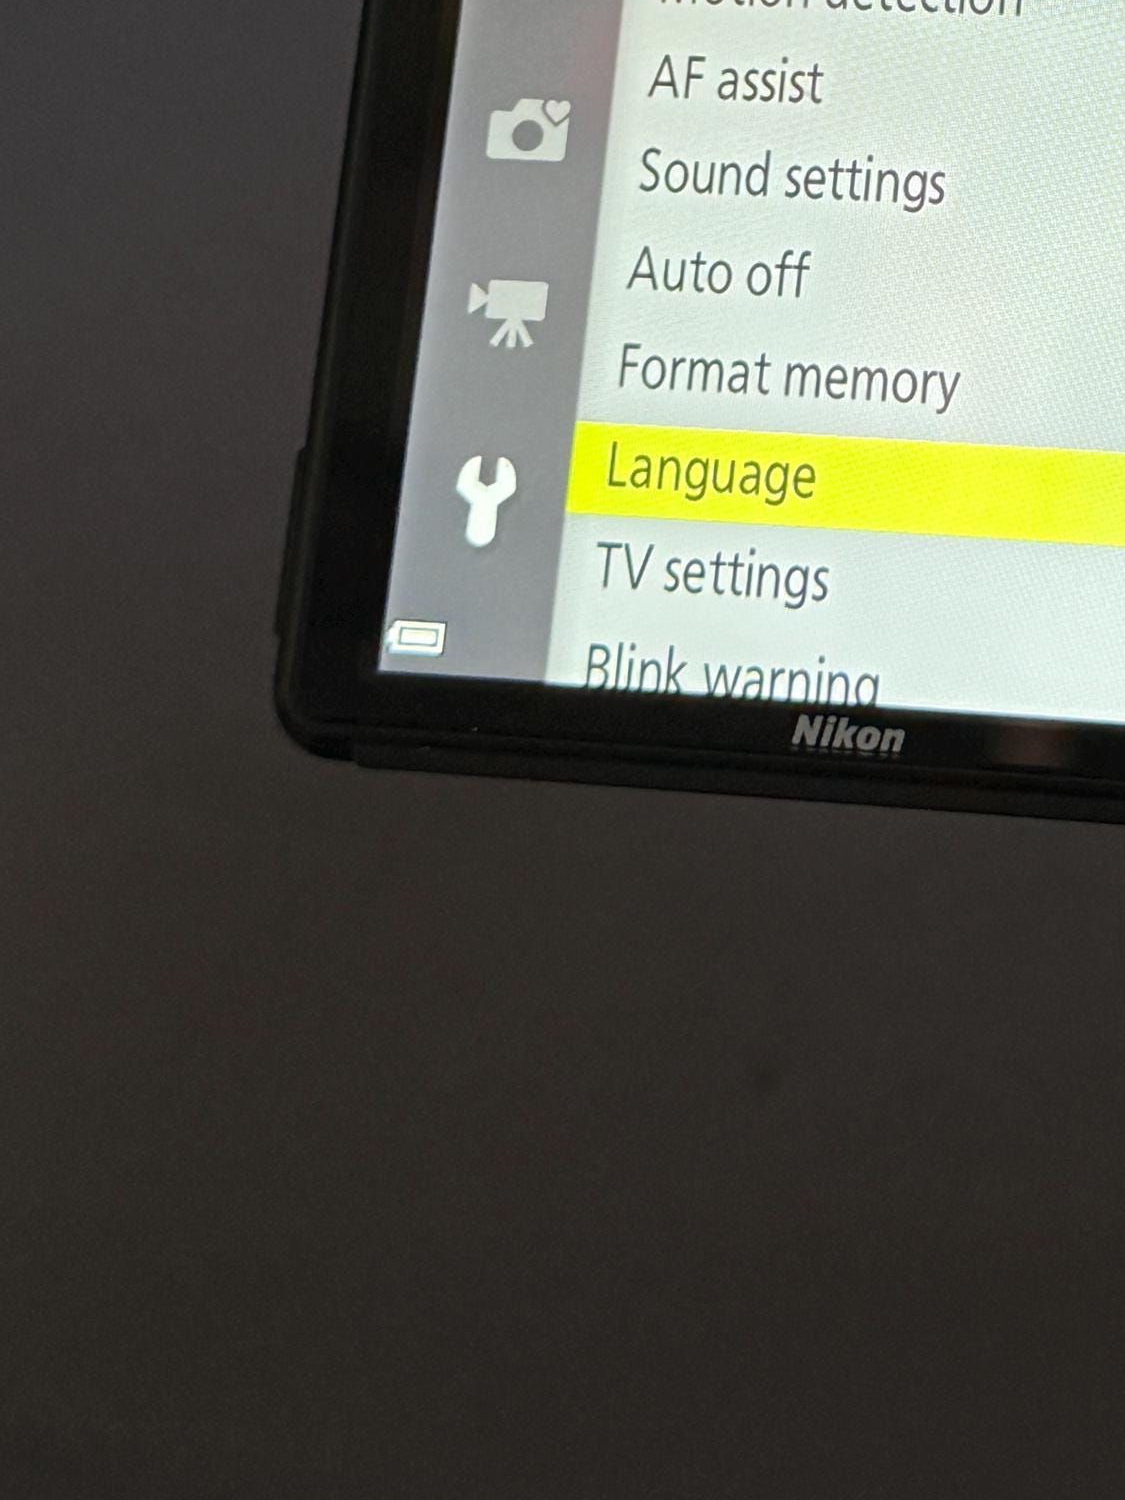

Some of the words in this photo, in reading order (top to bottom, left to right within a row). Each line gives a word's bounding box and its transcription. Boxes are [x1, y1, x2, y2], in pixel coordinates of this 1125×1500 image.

[648, 54, 707, 99] AF
[717, 57, 825, 104] assist
[639, 147, 773, 197] Sound
[784, 155, 947, 213] settings
[626, 245, 733, 295] Auto
[746, 250, 813, 299] off
[618, 343, 771, 397] Format
[783, 357, 962, 414] memory
[606, 441, 817, 506] Language
[596, 541, 656, 590] TV
[664, 547, 831, 610] settings
[583, 642, 690, 694] Blink
[702, 656, 881, 707] warning
[792, 714, 906, 752] Nikon
